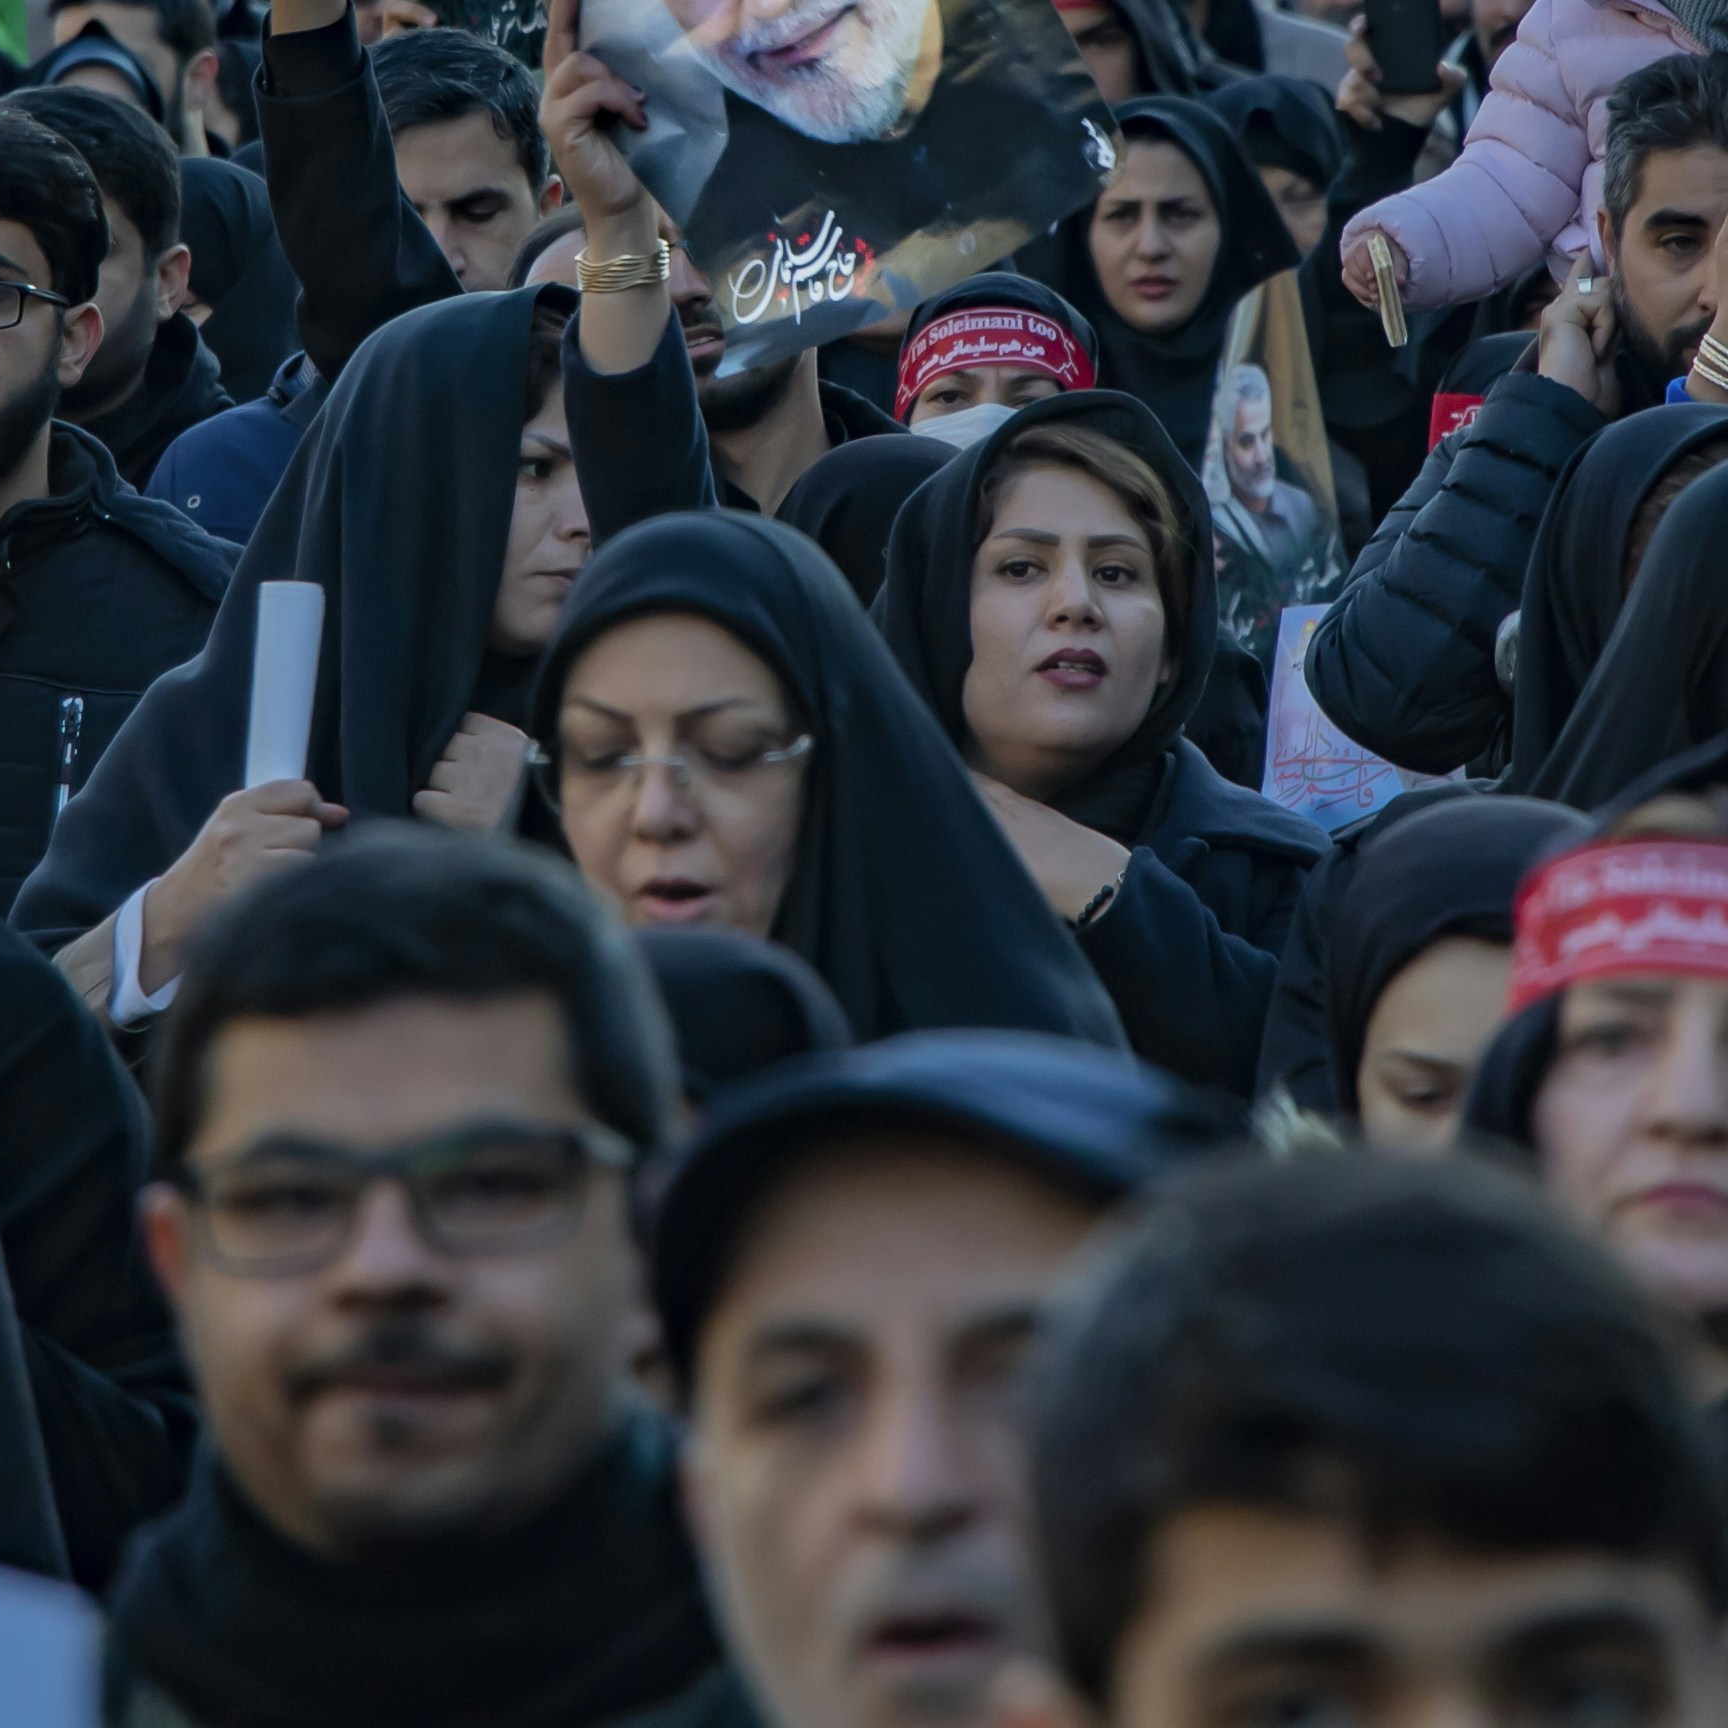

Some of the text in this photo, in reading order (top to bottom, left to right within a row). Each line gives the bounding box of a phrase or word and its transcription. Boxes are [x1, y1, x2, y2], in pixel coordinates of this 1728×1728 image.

[728, 209, 836, 325] سلیمانی
[911, 313, 1058, 364] I'm Soleimani too
[939, 335, 998, 366] سلیمانی
[999, 338, 1022, 357] هم
[1022, 342, 1045, 358] من
